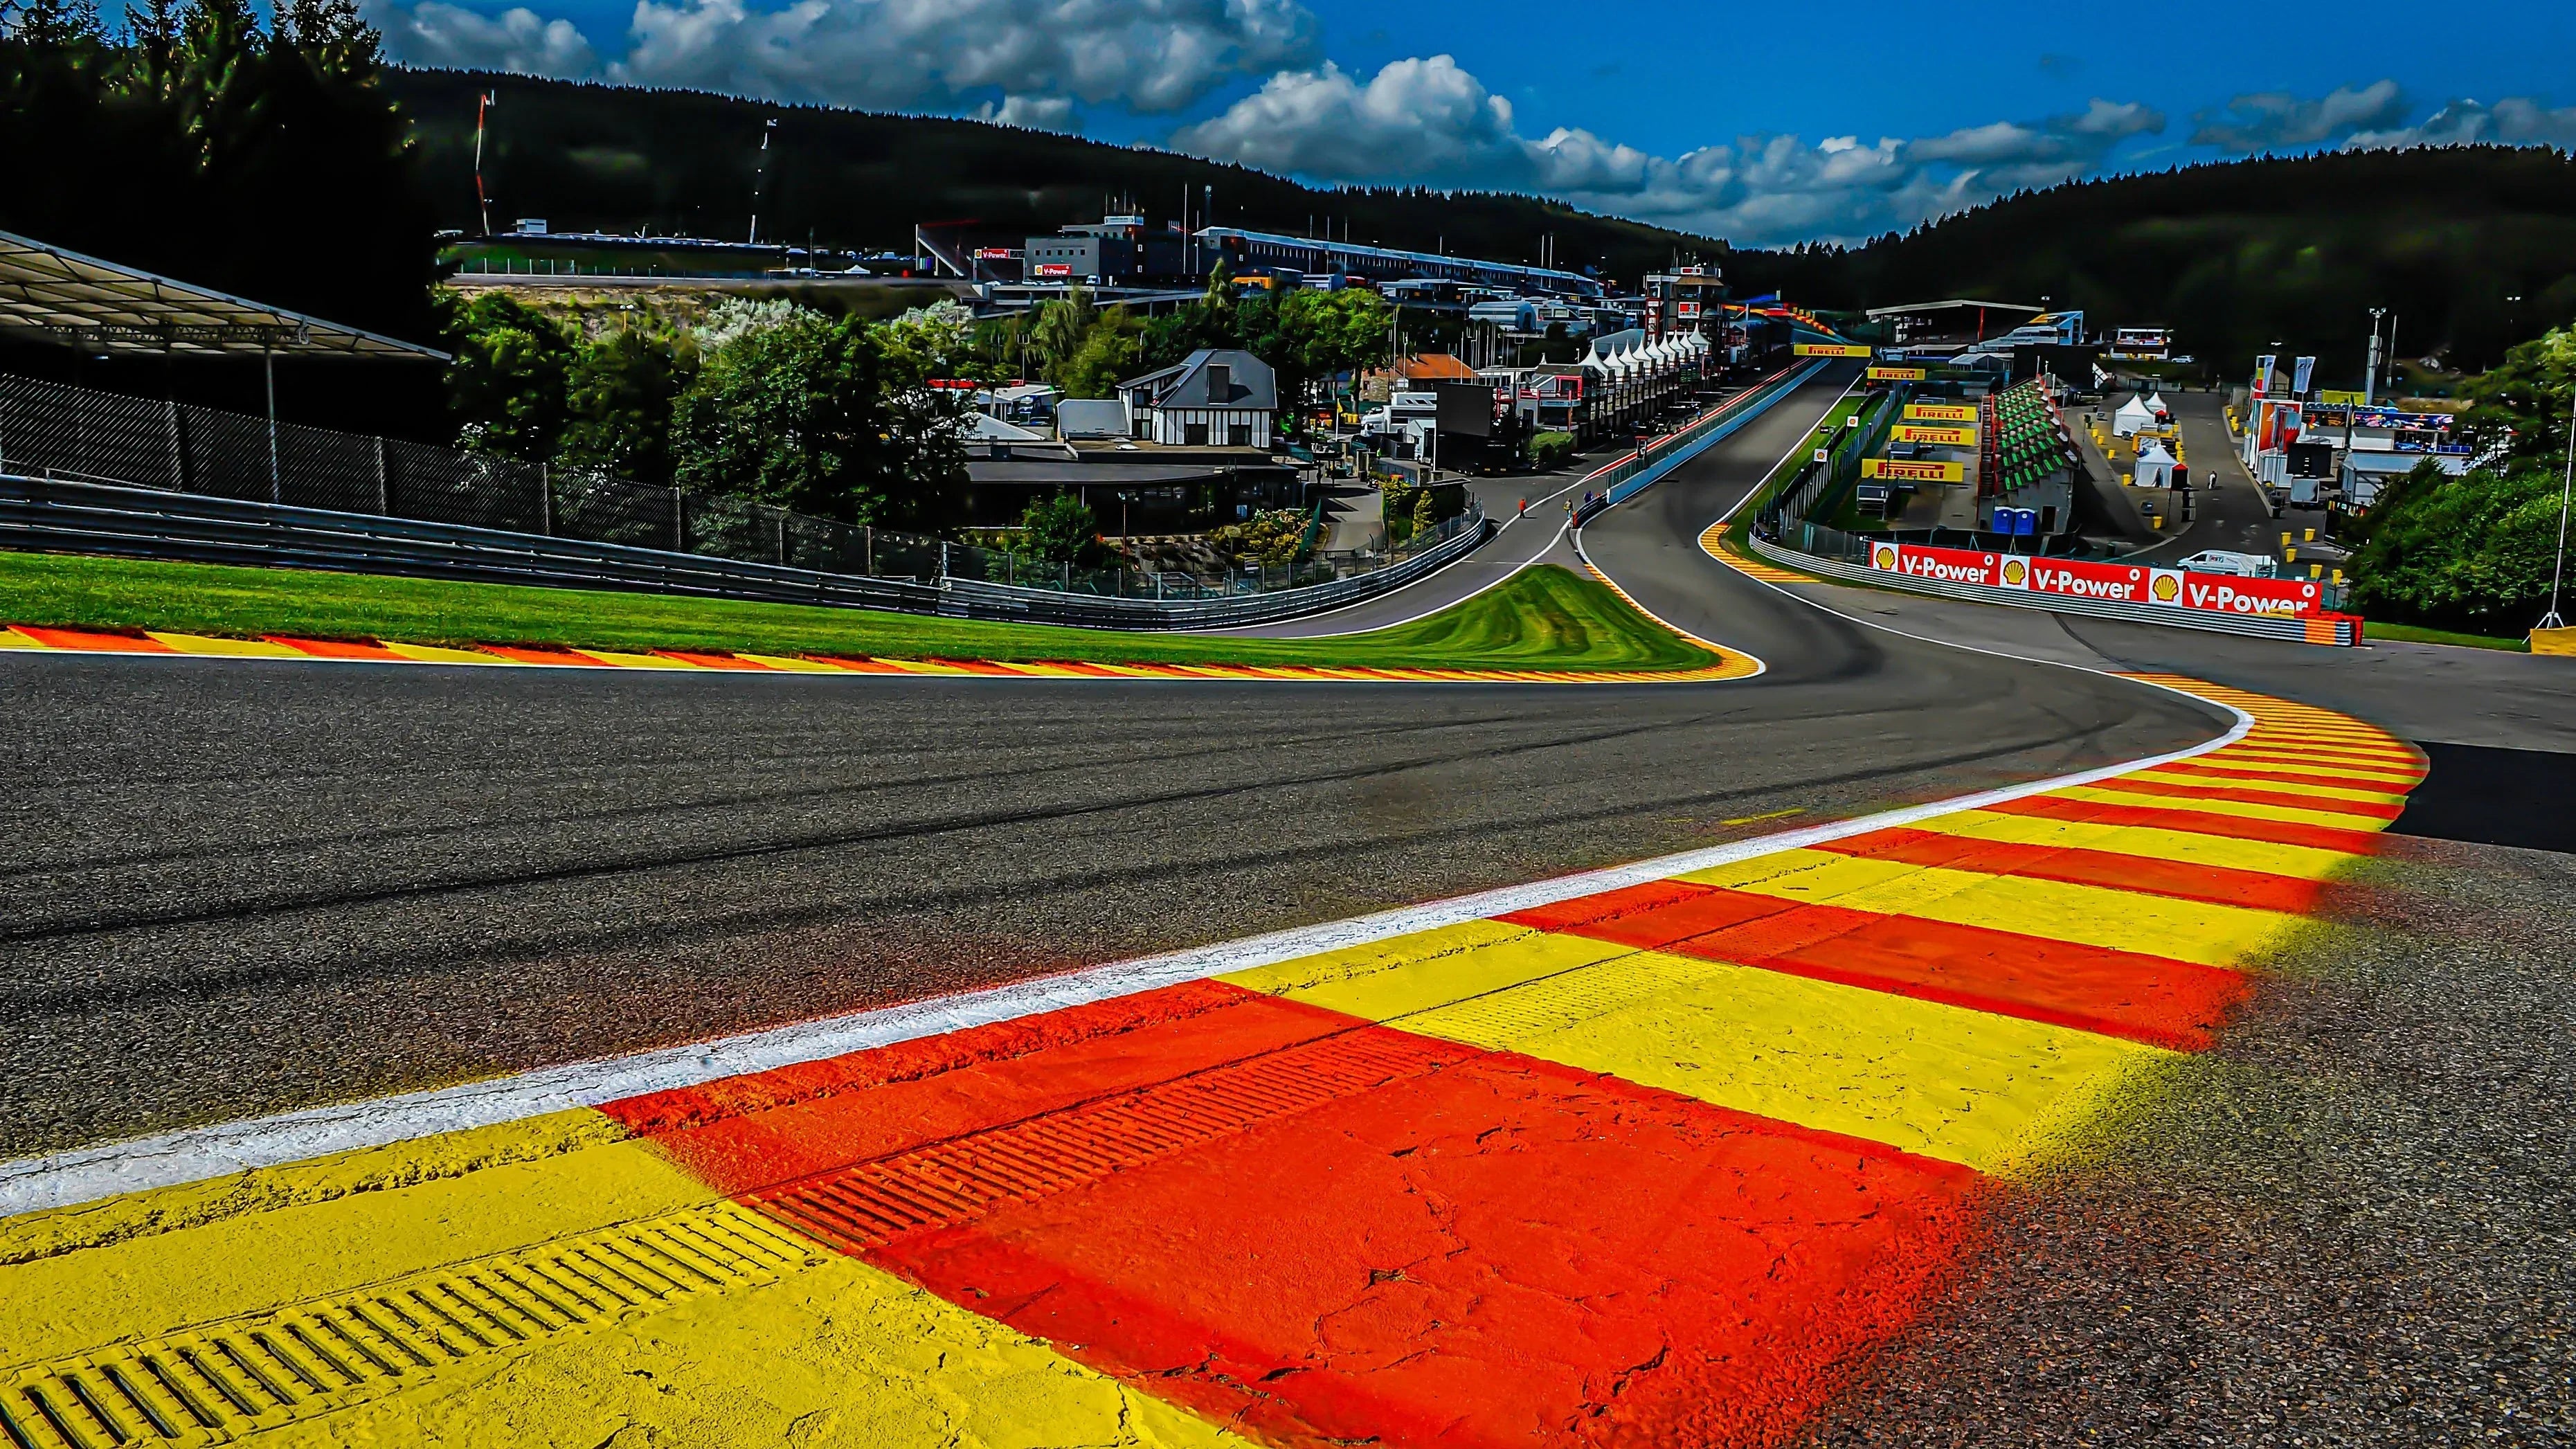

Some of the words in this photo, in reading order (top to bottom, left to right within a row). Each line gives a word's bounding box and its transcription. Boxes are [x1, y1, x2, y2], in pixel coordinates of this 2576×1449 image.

[1808, 346, 1846, 355] PIRELLI
[1877, 369, 1916, 379] PIRELLI
[1916, 407, 1964, 419] PIRELLI
[1905, 429, 1961, 442] PIRELLI
[1877, 462, 1945, 478] PIRELLI
[1902, 555, 1988, 583] V-Power
[2034, 568, 2135, 599] V-Power
